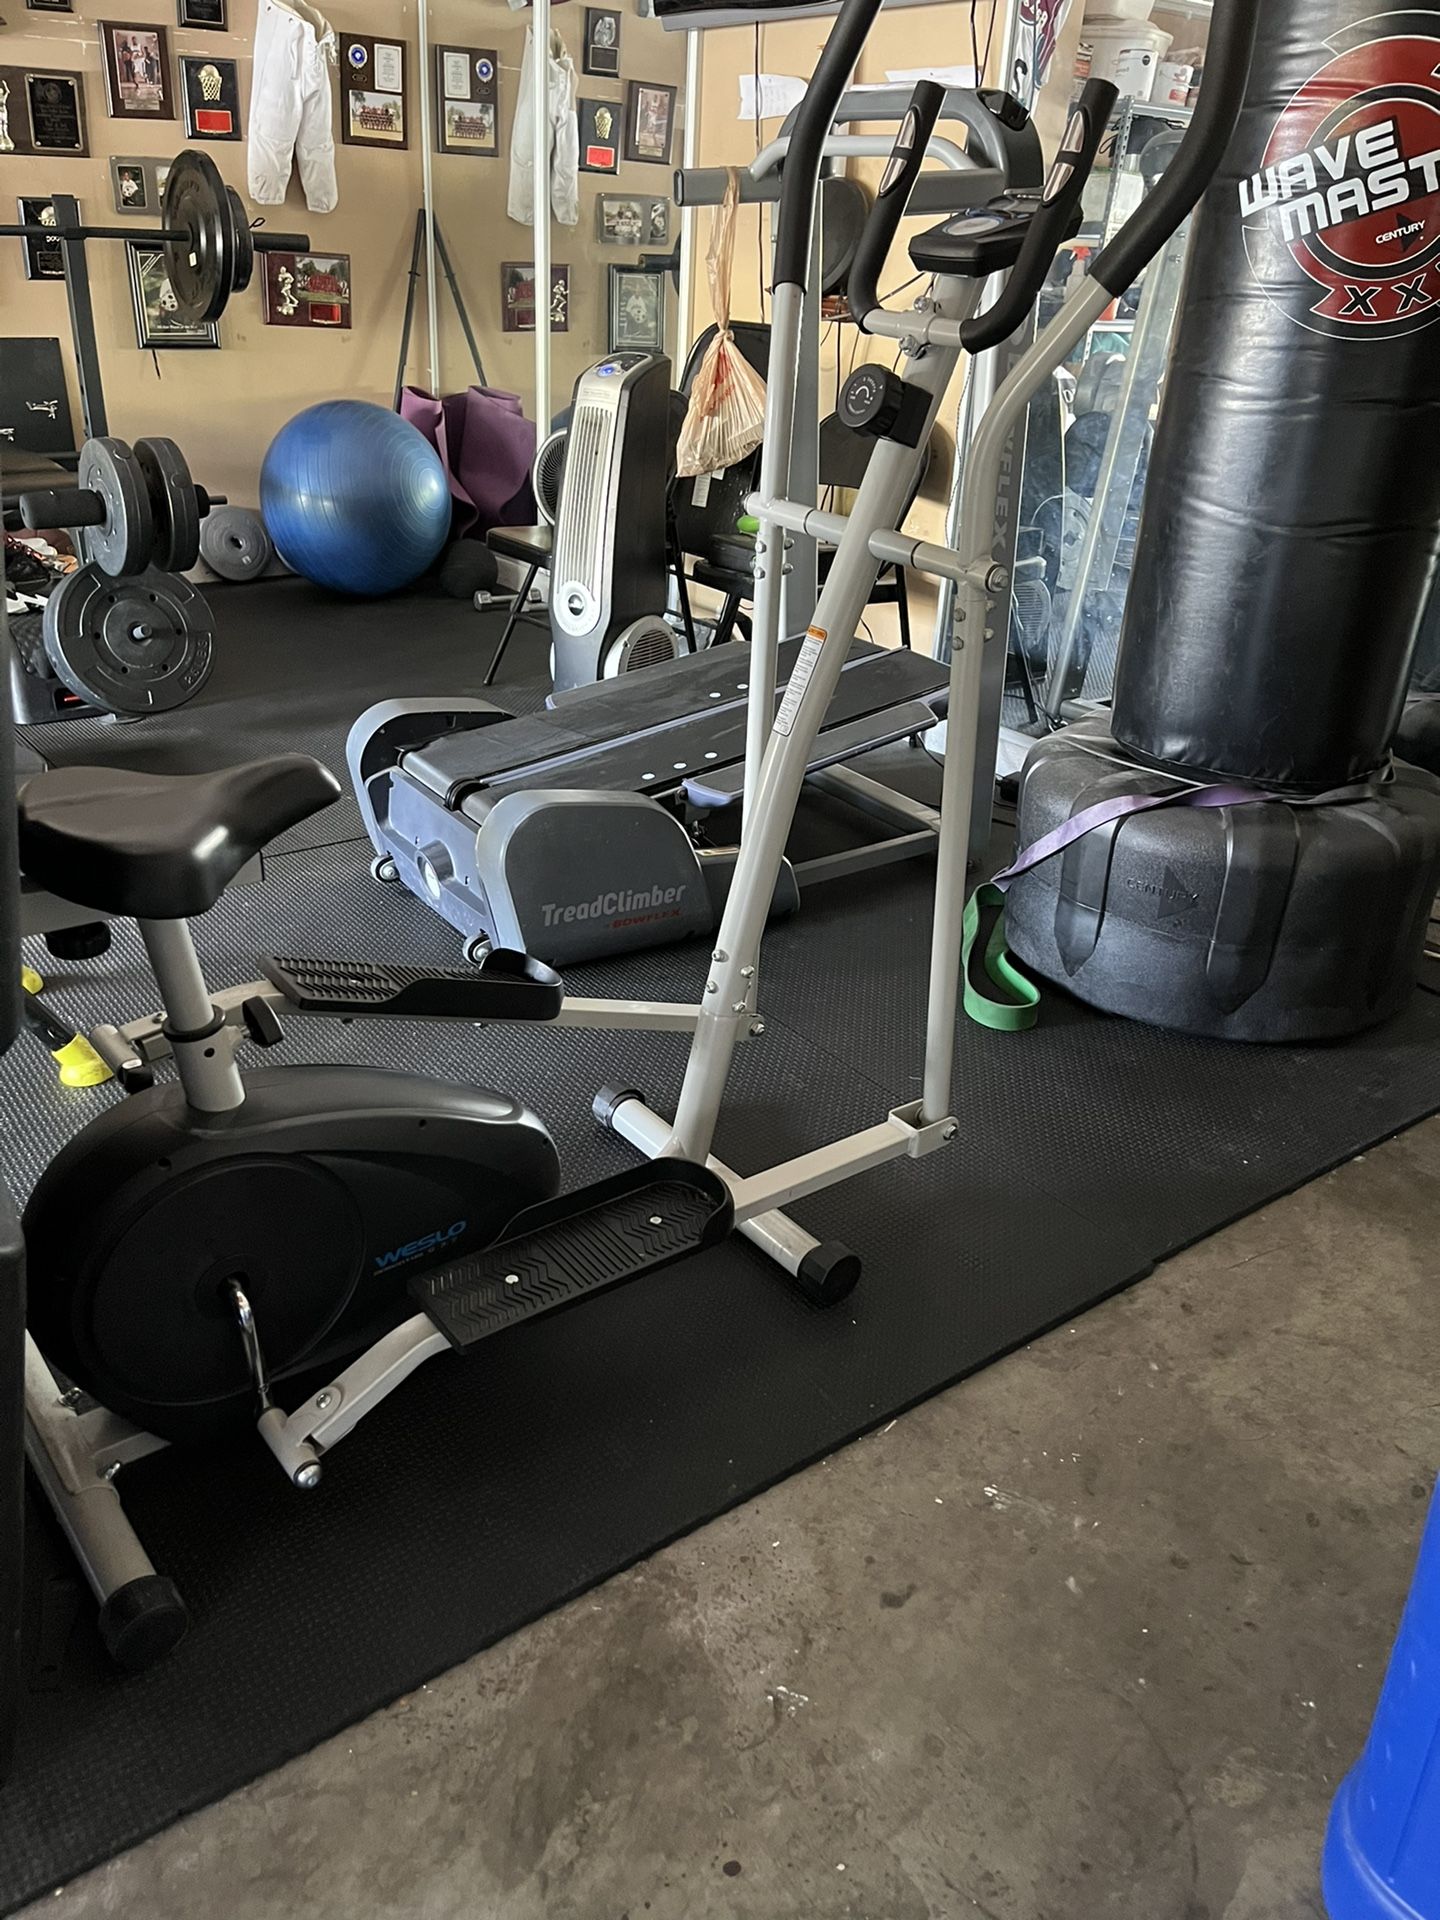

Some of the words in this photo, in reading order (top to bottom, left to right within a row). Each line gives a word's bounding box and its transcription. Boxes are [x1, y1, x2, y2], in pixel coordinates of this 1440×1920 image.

[1239, 119, 1399, 218] WAVE
[1279, 150, 1440, 242] MAST
[1375, 219, 1425, 244] CENTURY
[541, 884, 687, 927] TreadClimber
[612, 907, 681, 928] BOWFLEX
[375, 1220, 467, 1268] WESLO
